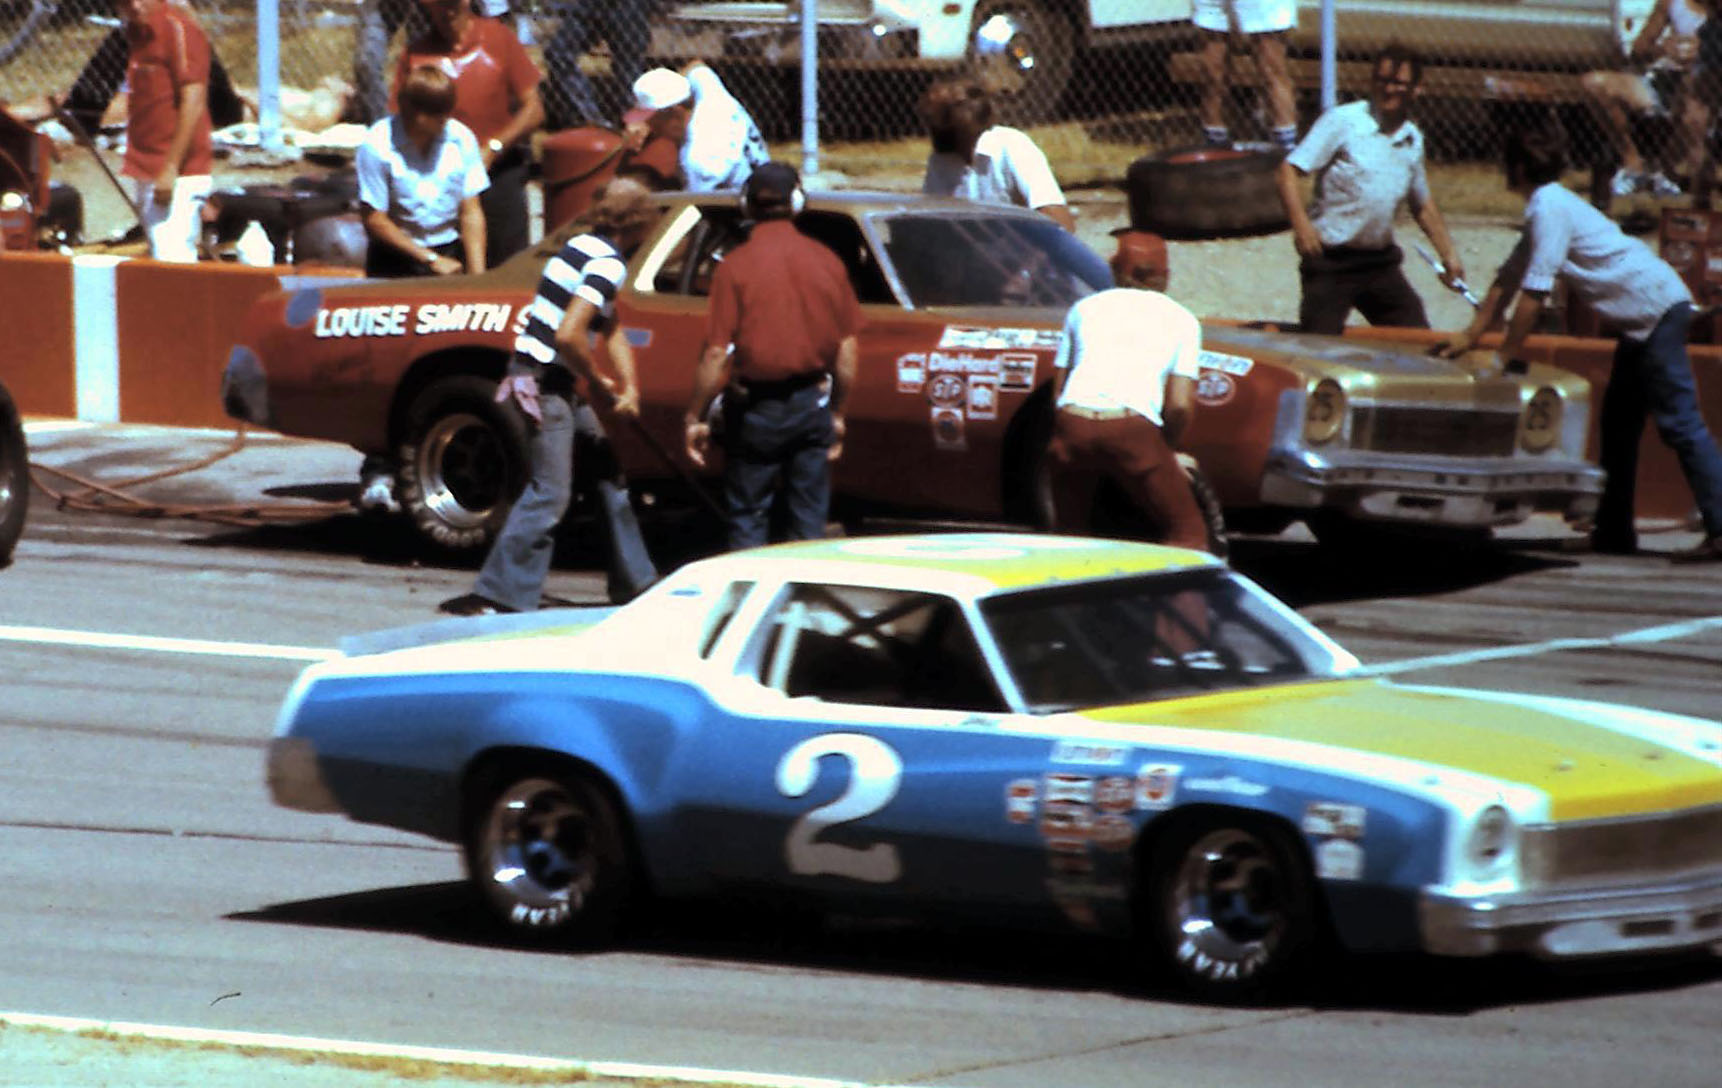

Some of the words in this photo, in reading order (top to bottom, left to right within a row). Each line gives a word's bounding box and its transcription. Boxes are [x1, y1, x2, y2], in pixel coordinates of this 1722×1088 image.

[315, 306, 409, 338] LOUISE
[415, 303, 512, 335] SMITH
[929, 352, 1001, 373] DieHard
[776, 733, 904, 883] 2
